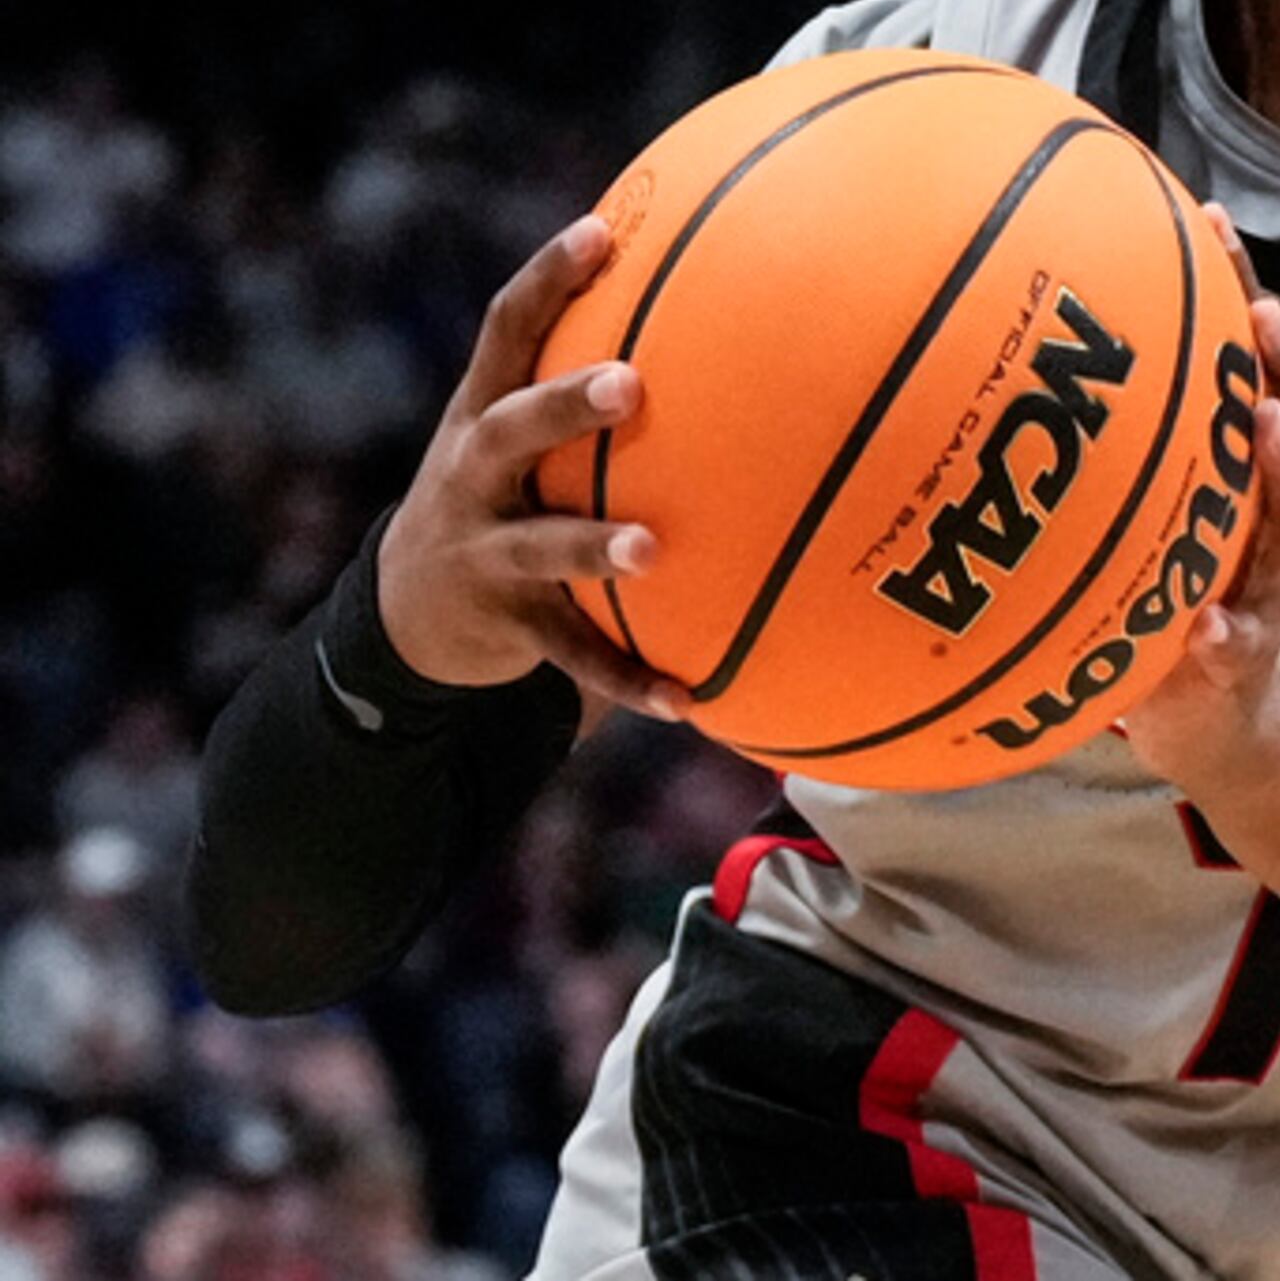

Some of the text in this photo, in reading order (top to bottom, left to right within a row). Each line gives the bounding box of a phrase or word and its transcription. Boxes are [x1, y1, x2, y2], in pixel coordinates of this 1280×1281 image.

[849, 269, 1051, 576] OFFICIAL GAME BALL
[872, 283, 1138, 640] NCAA
